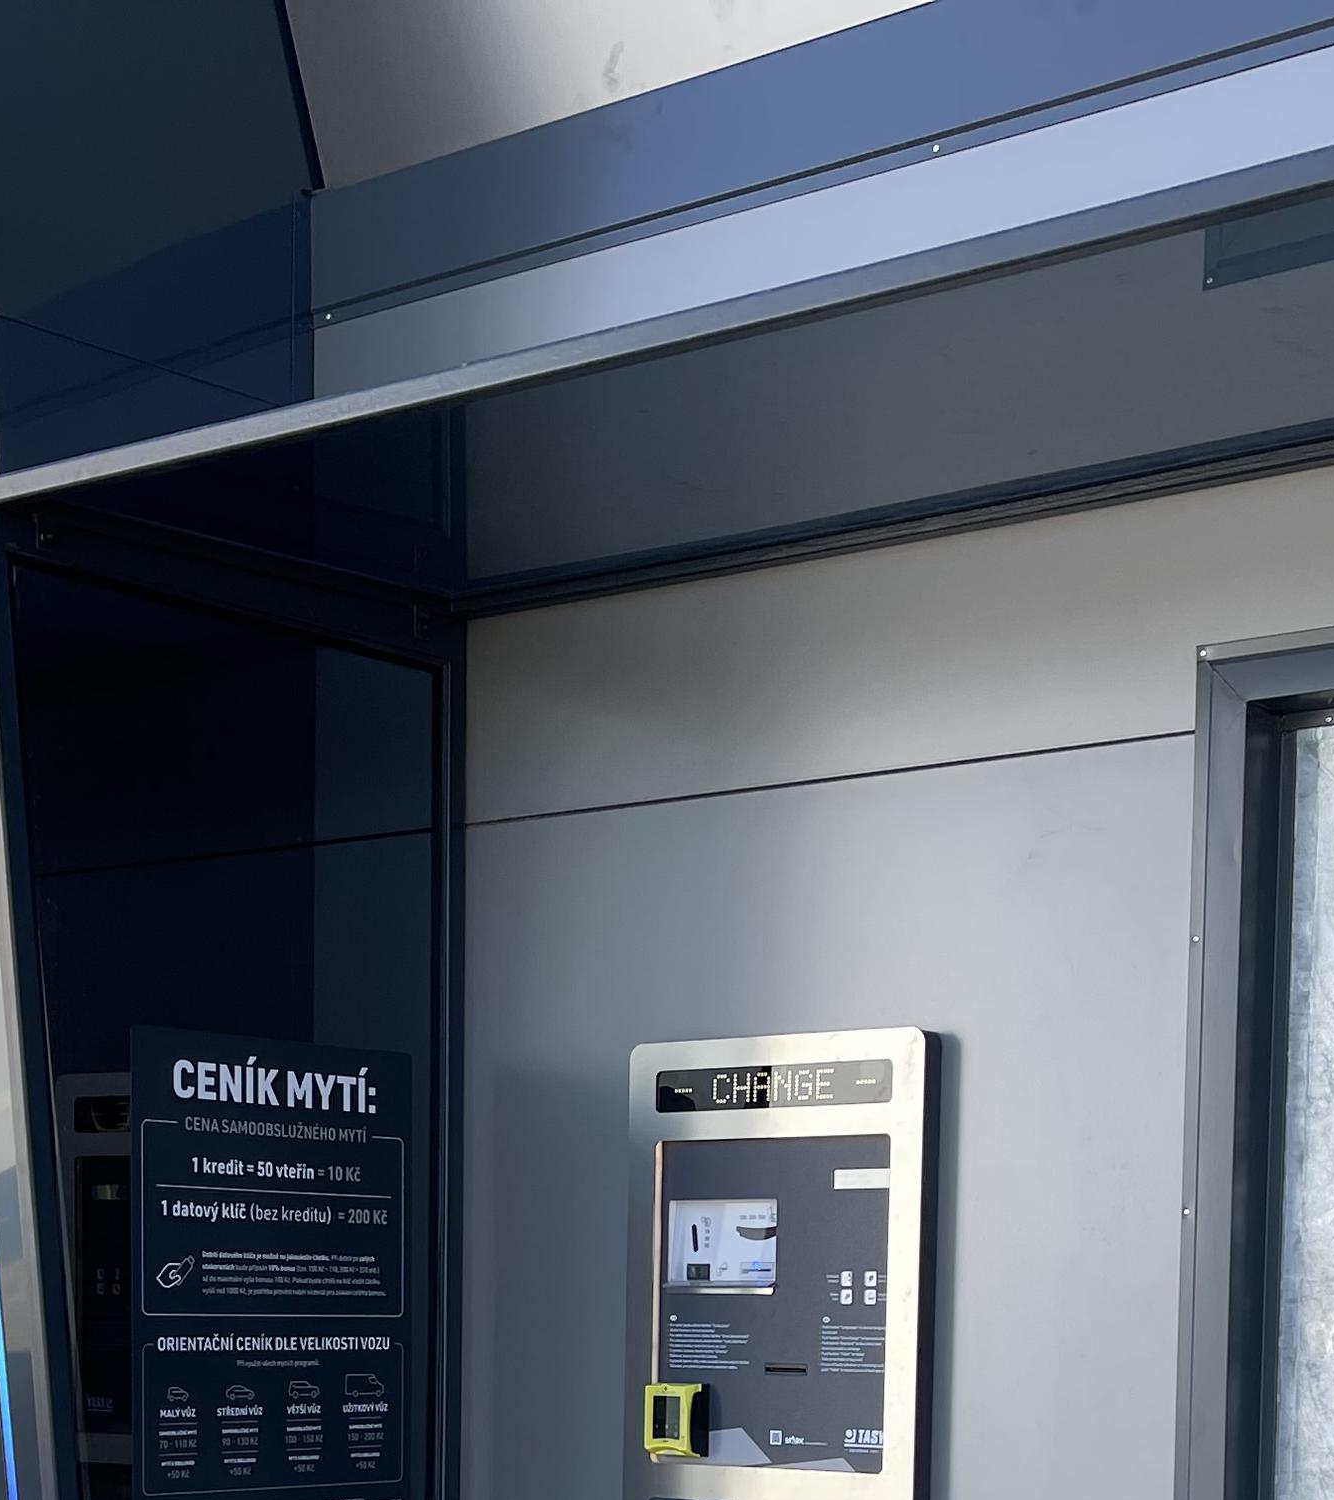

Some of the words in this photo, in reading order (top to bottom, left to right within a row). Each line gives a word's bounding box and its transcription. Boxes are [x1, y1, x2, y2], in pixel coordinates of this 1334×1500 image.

[173, 1056, 279, 1106] CENÍK
[287, 1067, 377, 1114] MYTÍ:
[712, 1068, 835, 1104] CHANGE
[185, 1116, 219, 1132] CENA
[221, 1119, 336, 1141] SAMOOBSLUŽNÉHO
[339, 1126, 367, 1143] MYTÍ
[191, 1157, 198, 1172] 1
[203, 1158, 244, 1176] kredit
[247, 1165, 254, 1173] =
[257, 1161, 273, 1177] 50
[275, 1162, 315, 1180] vteřin
[317, 1169, 325, 1177] =
[327, 1166, 343, 1181] 10
[345, 1166, 361, 1182] Kč
[161, 1200, 167, 1216] 1
[172, 1200, 219, 1222] datový
[221, 1202, 246, 1220] klíč
[249, 1204, 279, 1222] (bez
[281, 1207, 331, 1224] kreditu)
[338, 1212, 345, 1220] =
[347, 1209, 371, 1224] 200
[373, 1208, 387, 1224] Kč
[157, 1333, 234, 1352] ORIENTAČNÍ
[236, 1333, 273, 1352] CENÍK
[275, 1337, 298, 1351] DLE
[300, 1337, 359, 1351] VELIKOSTI
[361, 1336, 390, 1350] VOZU
[159, 1406, 179, 1418] MALÝ
[179, 1405, 196, 1418] VŮZ
